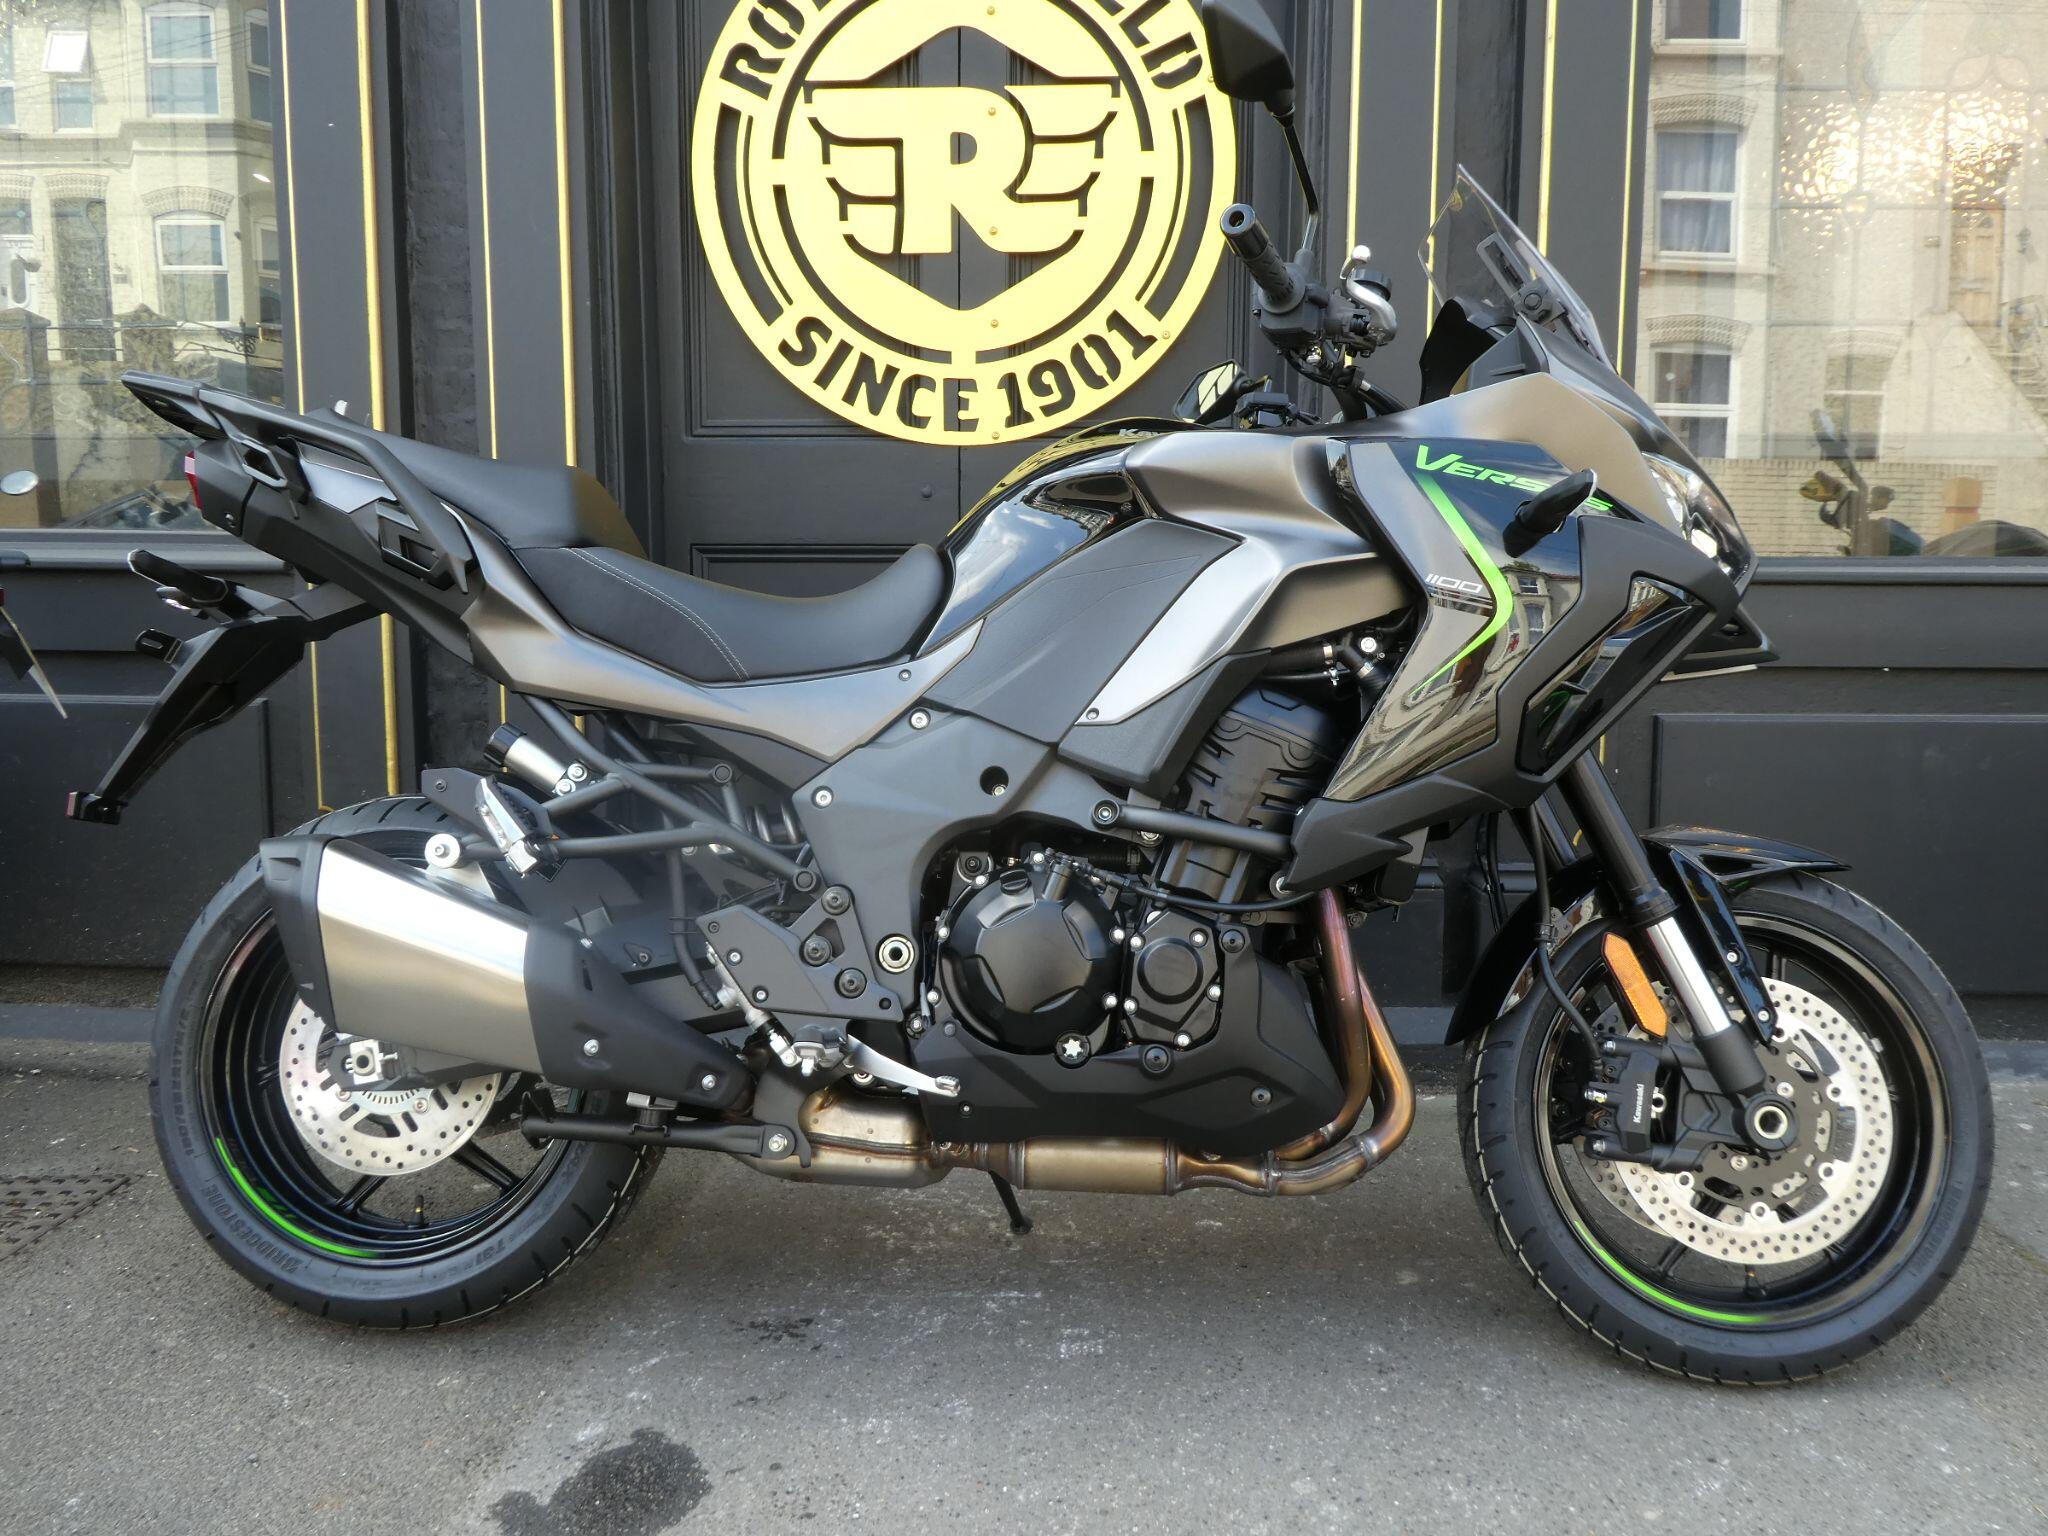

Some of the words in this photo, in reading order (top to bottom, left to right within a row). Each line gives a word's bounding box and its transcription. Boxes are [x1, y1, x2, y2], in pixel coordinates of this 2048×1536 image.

[777, 316, 979, 432] SINCE
[997, 308, 1159, 428] 1901
[1416, 444, 1614, 512] VERSS
[1425, 573, 1483, 594] 1100
[1633, 1083, 1644, 1123] Kawasaki
[200, 1183, 304, 1274] BRIDGESTONE
